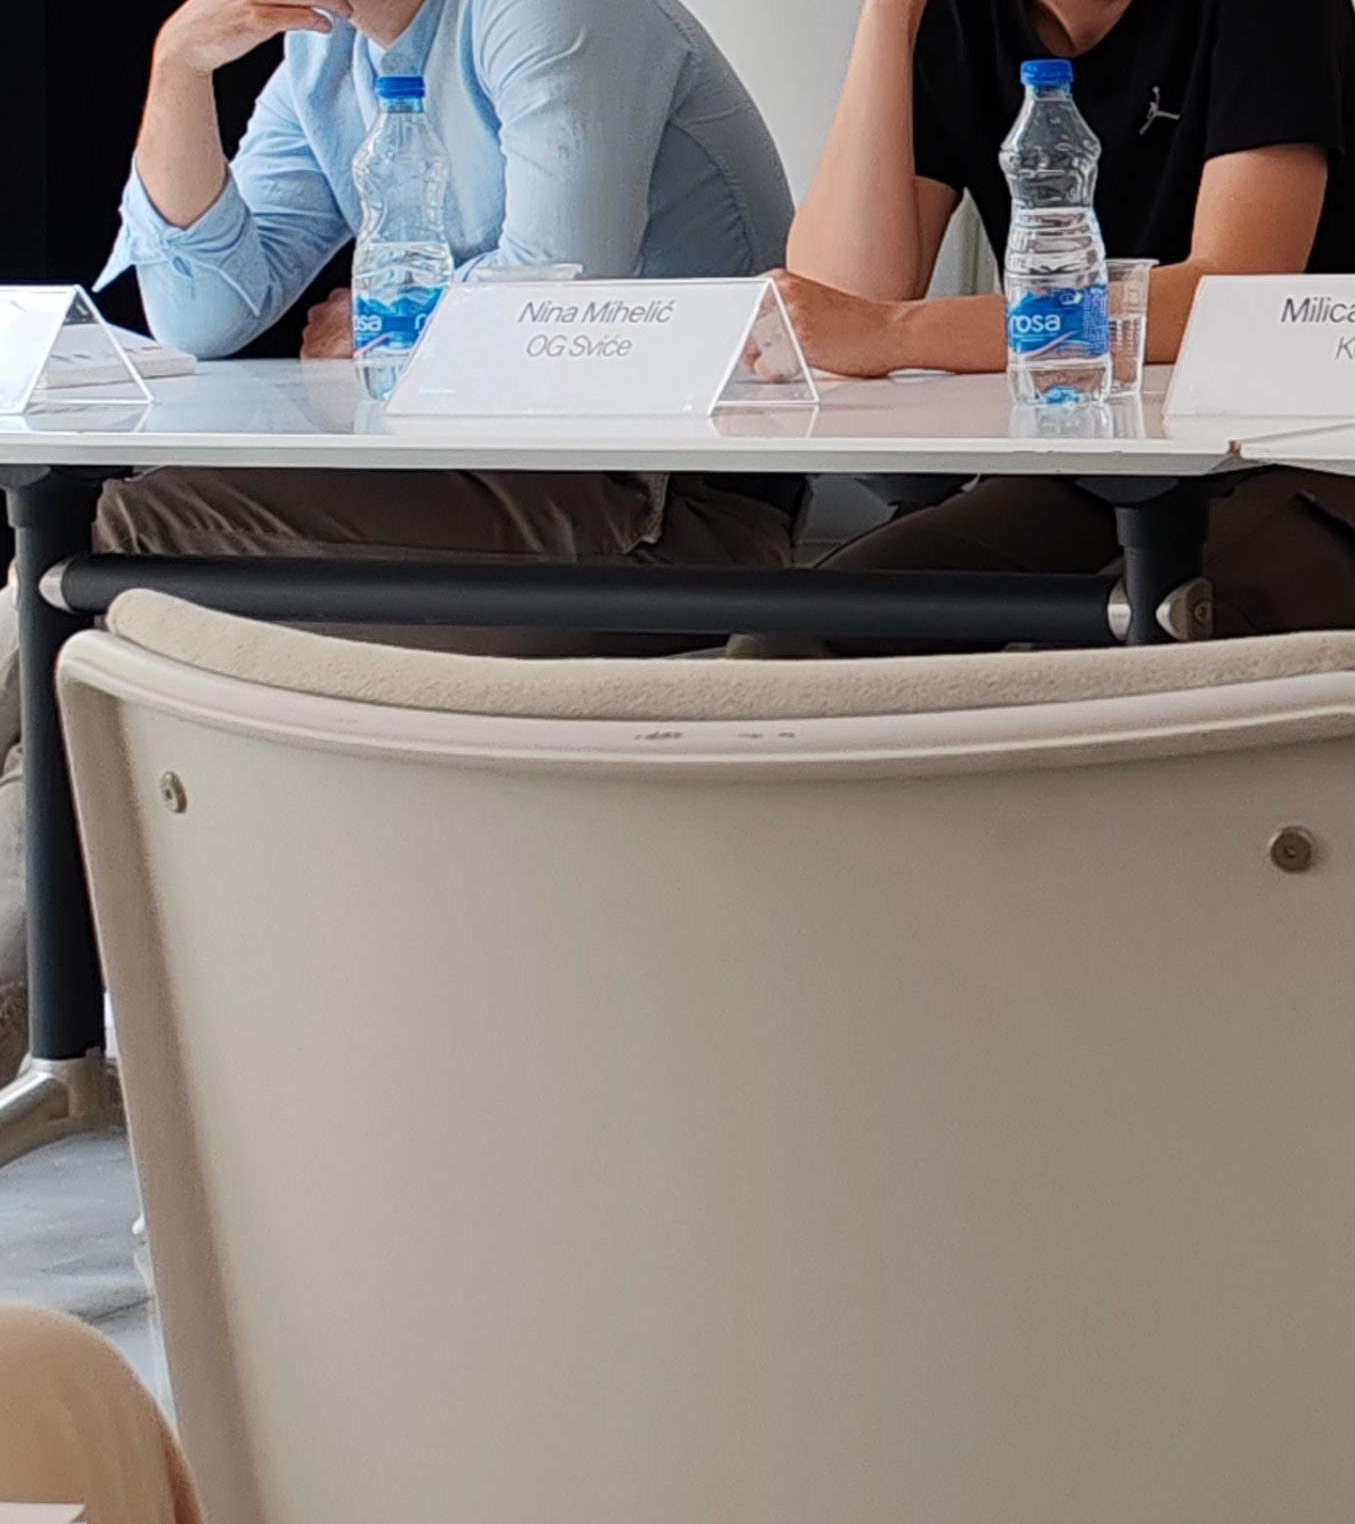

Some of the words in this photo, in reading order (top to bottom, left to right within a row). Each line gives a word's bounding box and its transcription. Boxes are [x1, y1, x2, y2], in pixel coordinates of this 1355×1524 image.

[518, 301, 579, 324] Nina
[580, 299, 676, 324] Mihelić
[526, 334, 567, 357] OG
[568, 334, 633, 357] Sviće
